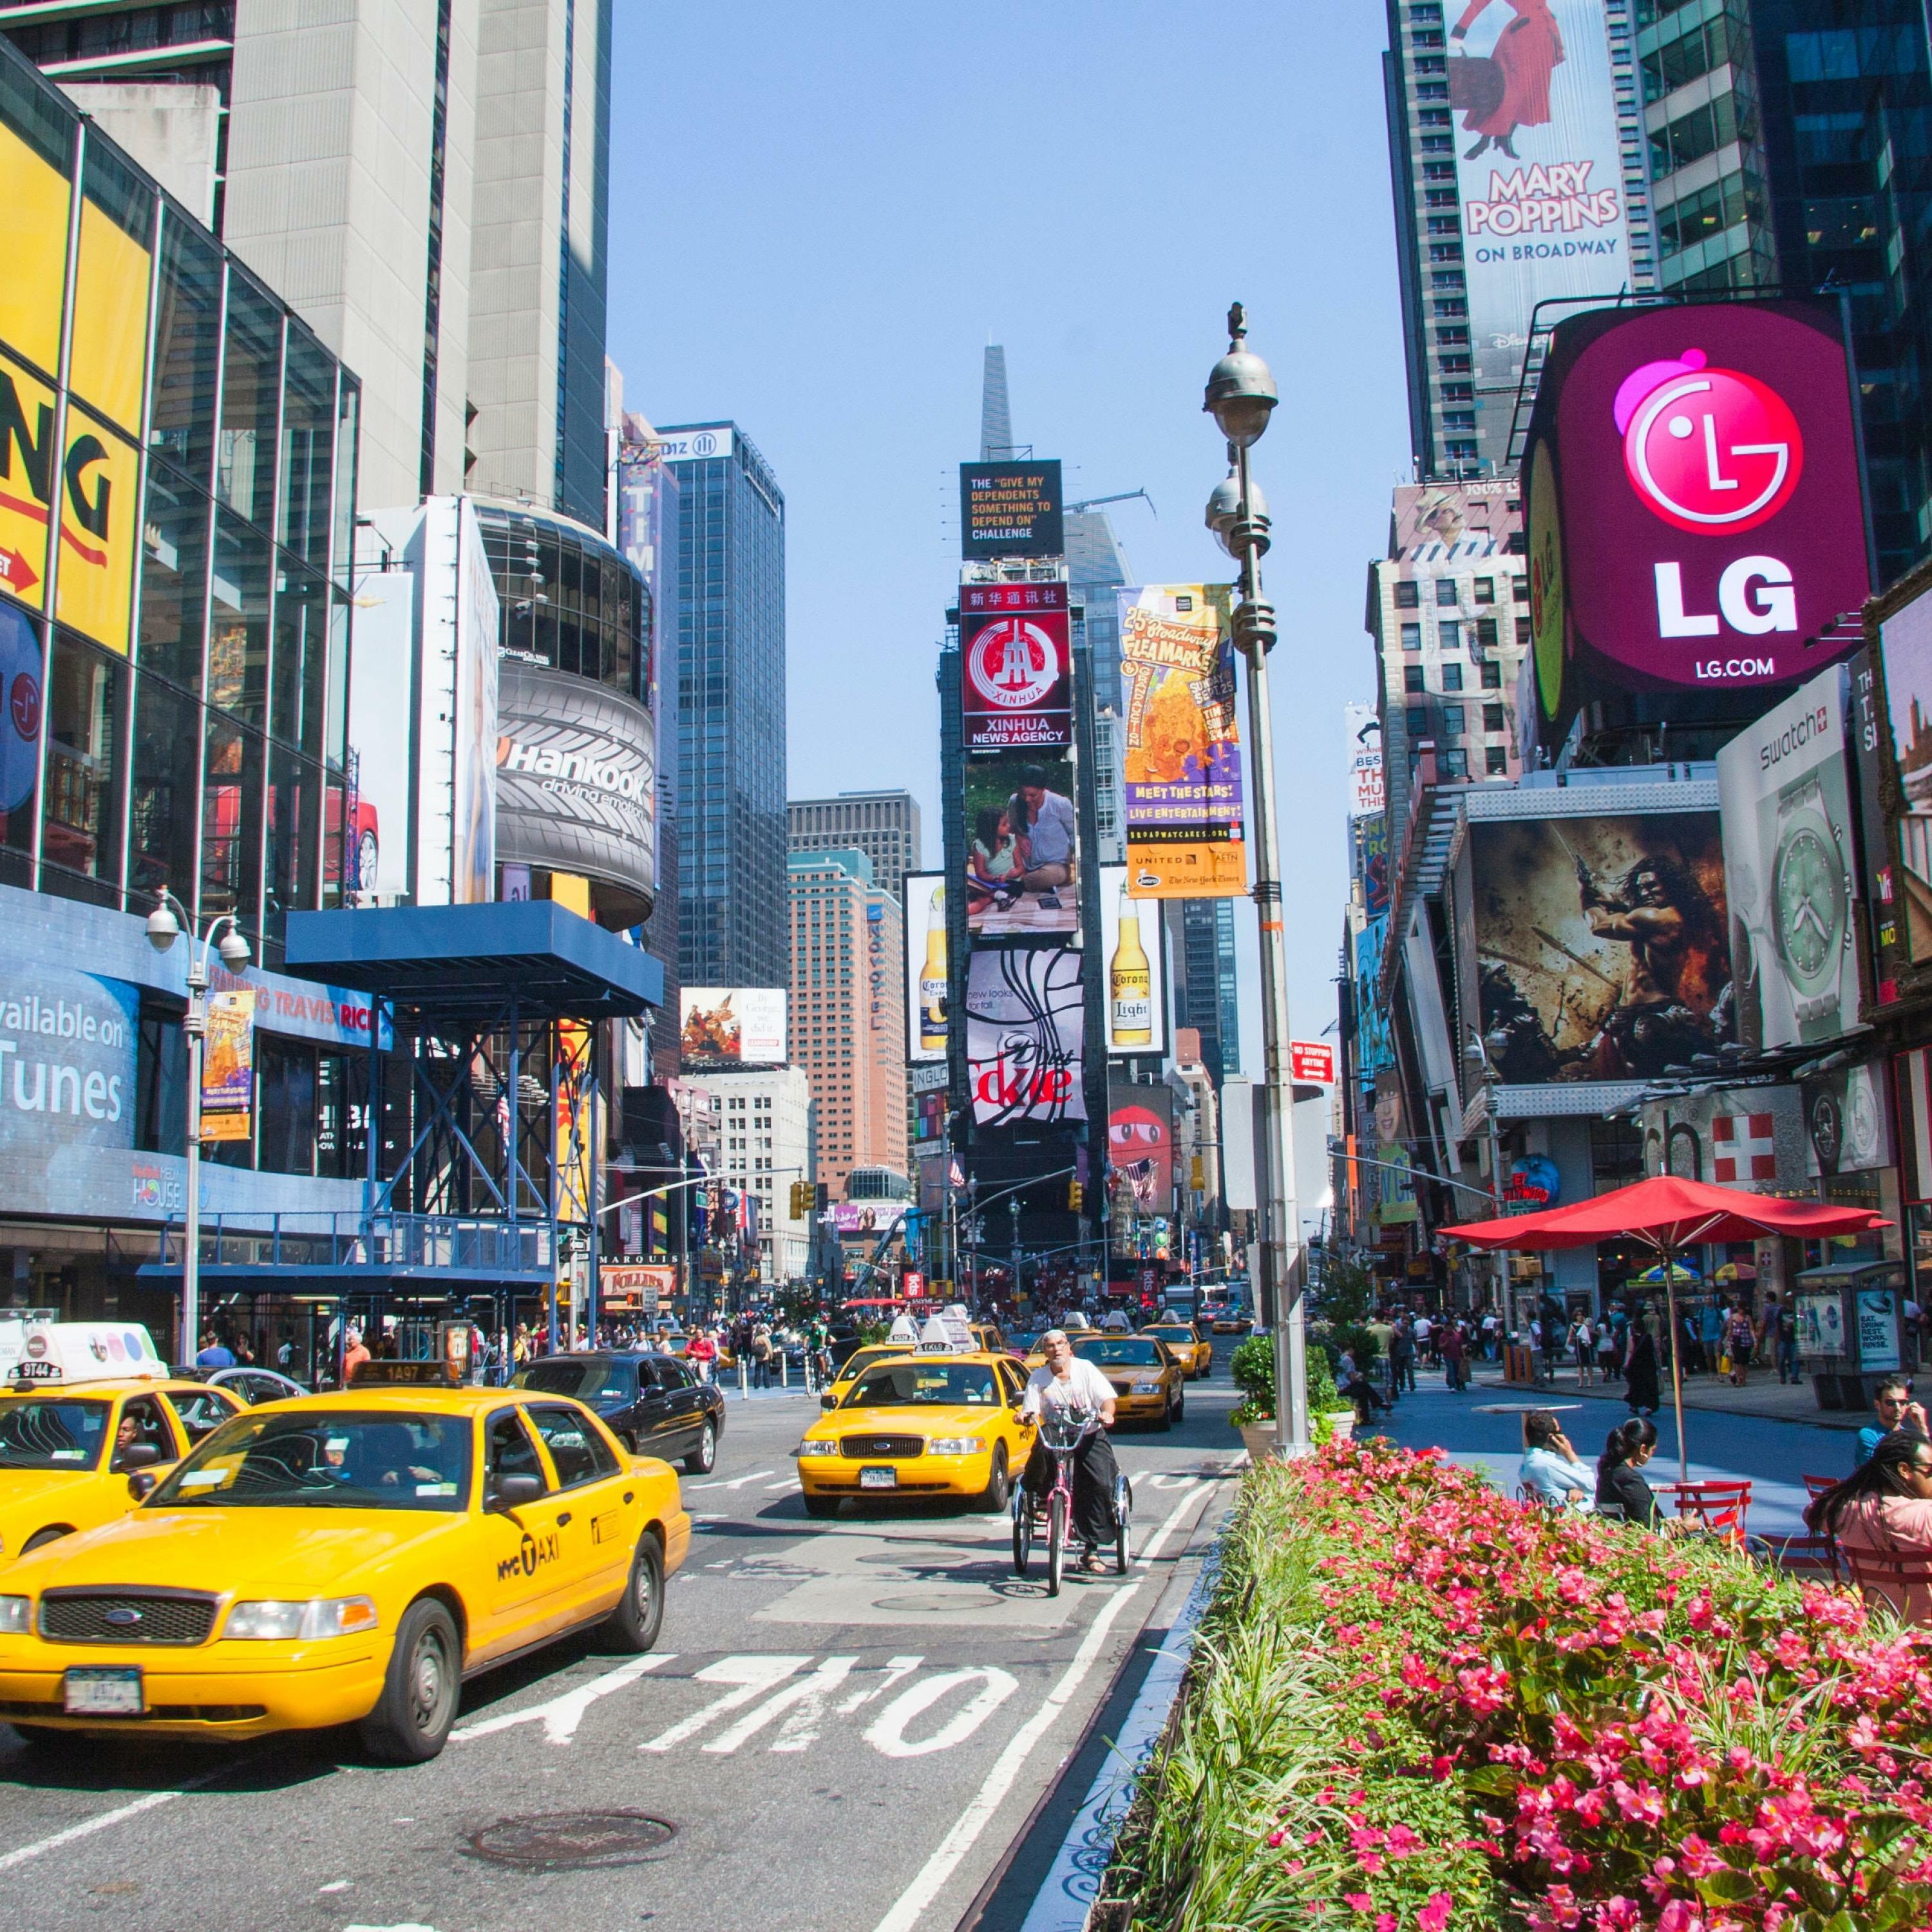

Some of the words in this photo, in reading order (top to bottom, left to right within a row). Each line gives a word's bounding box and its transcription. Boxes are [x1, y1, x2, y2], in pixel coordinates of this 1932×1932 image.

[1489, 161, 1593, 202] MARY
[1466, 189, 1619, 236] POPPINS
[1475, 247, 1505, 263] ON
[1513, 239, 1618, 260] BROADWAY
[971, 478, 991, 489] THE
[1027, 477, 1044, 487] MY
[971, 490, 1039, 502] DEPENDENTS
[972, 503, 1034, 514] SOMETHING
[1037, 502, 1051, 512] TO
[972, 516, 1013, 527] DEPEND
[626, 486, 654, 583] TIM
[972, 528, 1033, 540] CHALLENGE
[970, 590, 1057, 606] 新华通讯社
[1654, 554, 1798, 638] LG
[1148, 620, 1217, 654] Broadway
[1121, 634, 1156, 661] FLEA
[1159, 641, 1220, 673] MARKET
[1696, 658, 1774, 679] LG.COM
[1190, 673, 1224, 693] SUNDAY
[993, 687, 1044, 705] XINHUA
[987, 717, 1050, 732] XINHUA
[972, 732, 1009, 744] NEWS
[1011, 731, 1063, 743] AGENCY
[1760, 712, 1817, 771] swatch
[1356, 755, 1381, 766] BES
[1135, 786, 1168, 799] MEET
[1170, 786, 1191, 799] THE
[1193, 784, 1233, 799] STARS!
[1358, 783, 1385, 797] MU
[542, 779, 599, 804] driving
[601, 793, 645, 820] emotion
[1130, 808, 1152, 819] LIVE
[1155, 806, 1241, 819] ENTERTAINMENT!
[1130, 830, 1228, 839] BROADWAYCARES.ORG
[869, 925, 882, 1030] NOVOTEL
[1113, 974, 1148, 987] Corona
[989, 989, 1014, 998] looks
[274, 990, 336, 1025] TRAVIS
[340, 1004, 371, 1031] RIC
[969, 1002, 980, 1010] for
[1116, 1001, 1146, 1018] Light
[101, 1019, 122, 1048] on
[1294, 1046, 1303, 1054] NO
[1304, 1046, 1331, 1057] STOPPING
[1302, 1057, 1325, 1068] ANYTIME
[133, 1178, 180, 1208] HOUSE
[1144, 1270, 1155, 1292] tkts
[24, 1363, 48, 1377] 9T44
